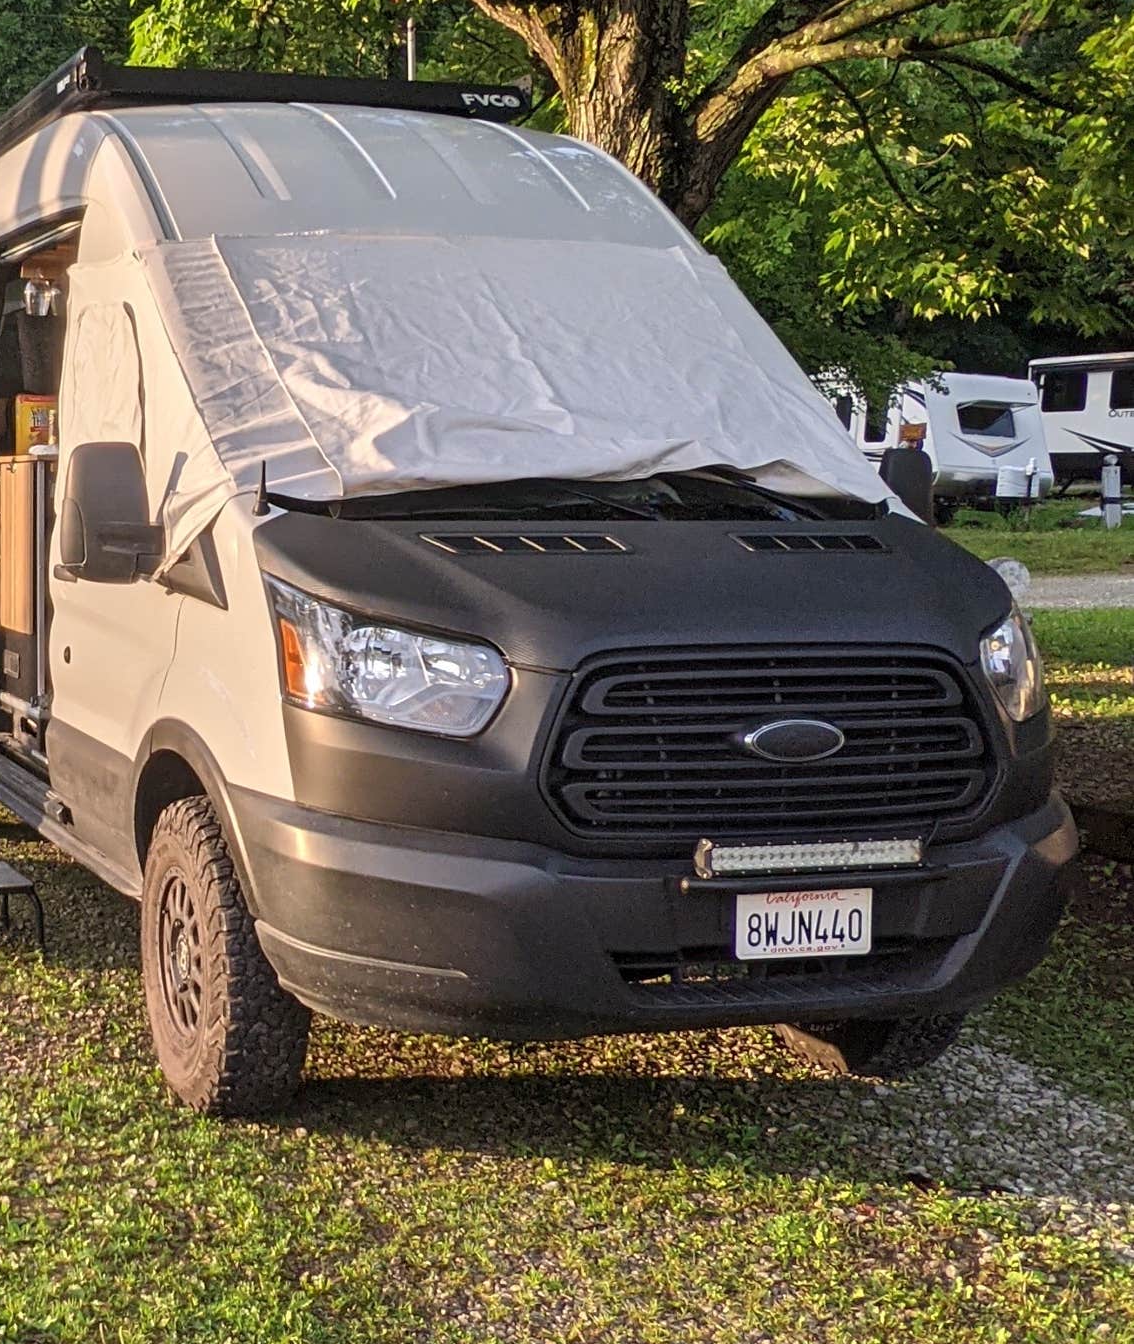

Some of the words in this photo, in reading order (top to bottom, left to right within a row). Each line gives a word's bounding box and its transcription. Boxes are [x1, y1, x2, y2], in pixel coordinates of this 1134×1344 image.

[766, 891, 847, 908] California
[747, 908, 863, 947] 8WJN440
[770, 944, 839, 953] dmv.ca.gov
